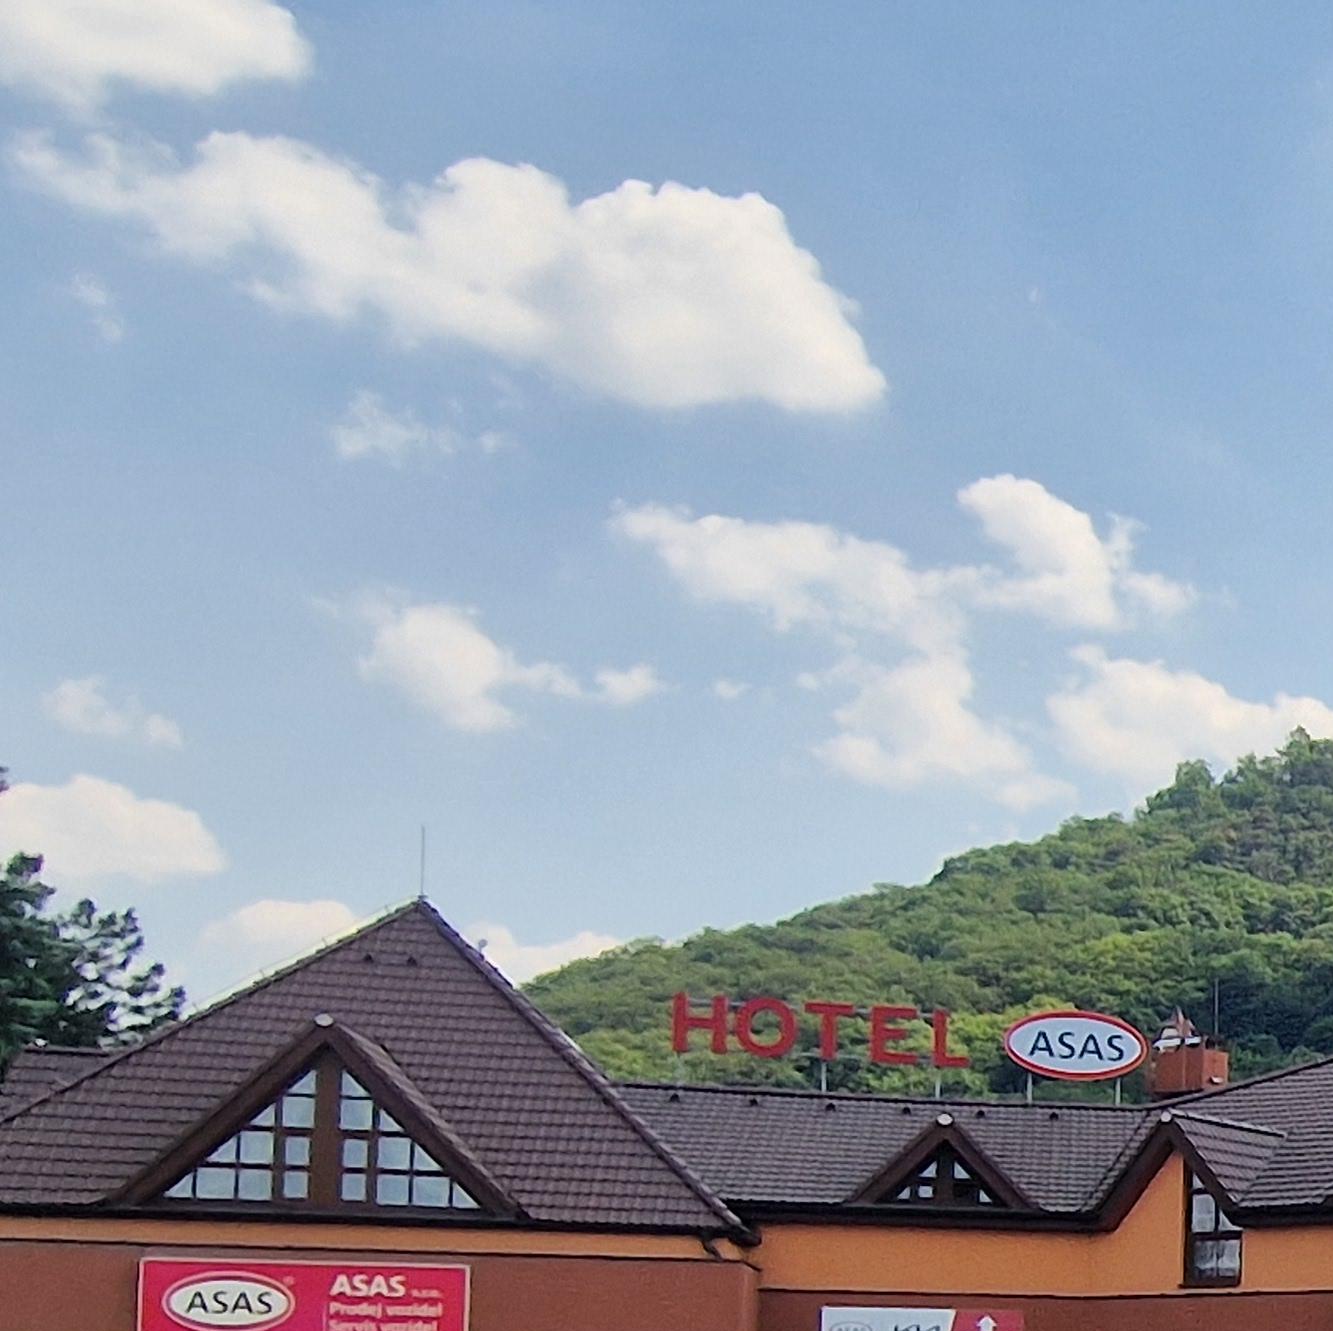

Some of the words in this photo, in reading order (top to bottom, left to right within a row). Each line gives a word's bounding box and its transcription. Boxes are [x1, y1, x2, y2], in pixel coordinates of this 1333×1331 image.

[671, 991, 972, 1069] HOTEL
[1027, 1029, 1126, 1063] ASAS
[329, 1273, 407, 1298] ASAS
[185, 1290, 274, 1316] ASAS
[329, 1301, 383, 1319] Prodej
[385, 1301, 443, 1317] vozidel
